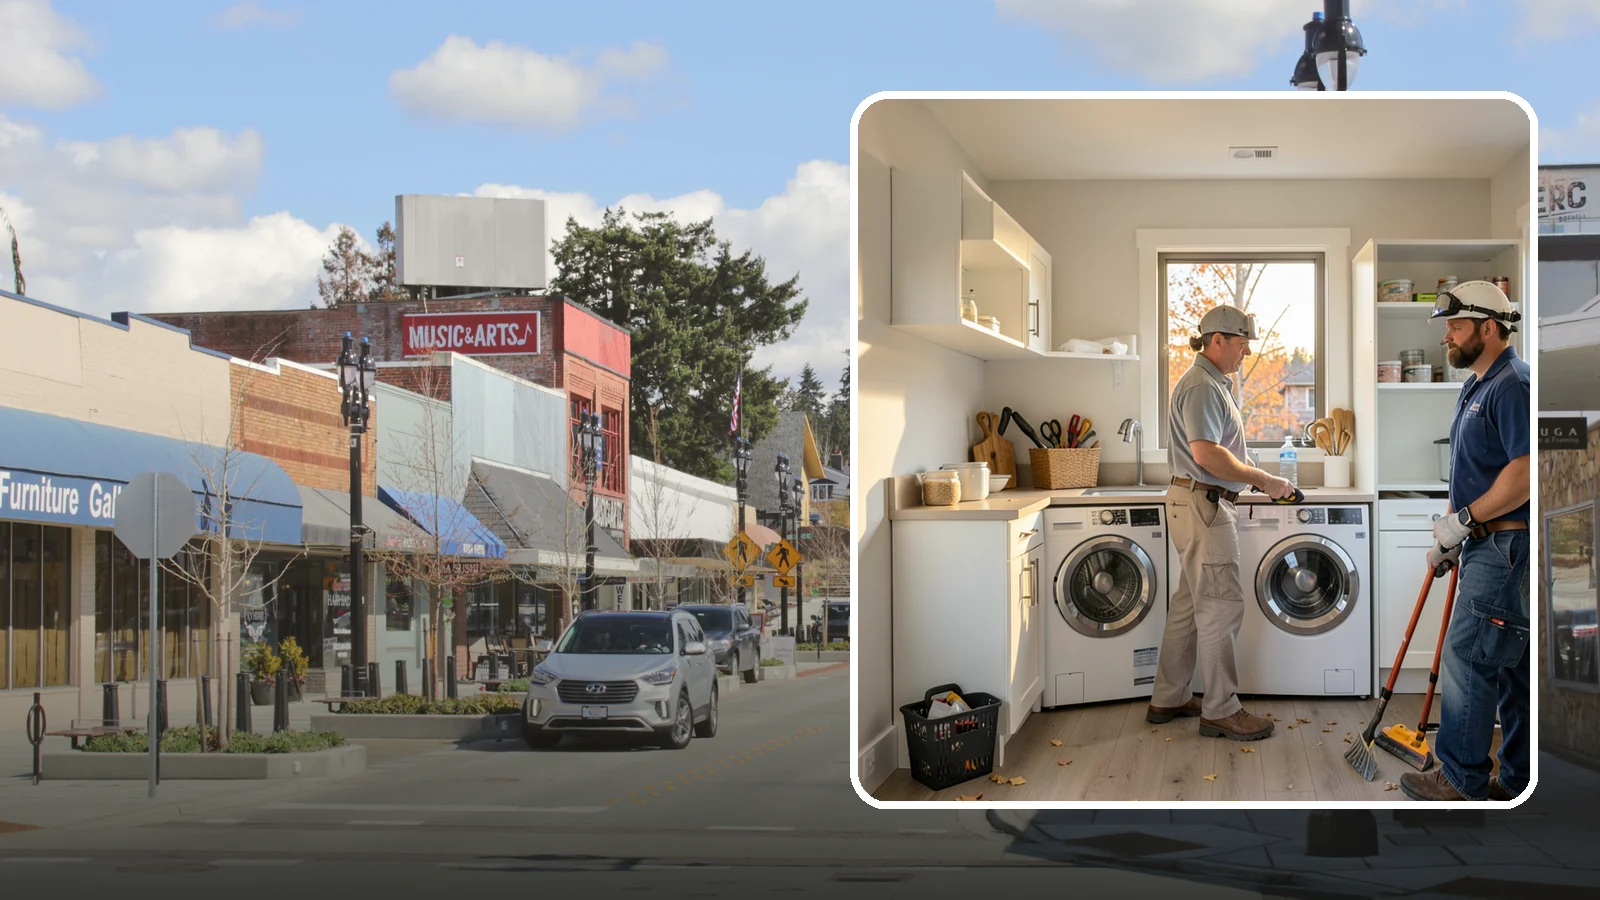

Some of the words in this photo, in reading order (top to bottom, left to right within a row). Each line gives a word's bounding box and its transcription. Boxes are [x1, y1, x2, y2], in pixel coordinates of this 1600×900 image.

[0, 471, 79, 516] Furniture
[89, 482, 121, 519] Gal
[452, 563, 478, 574] SUSHI
